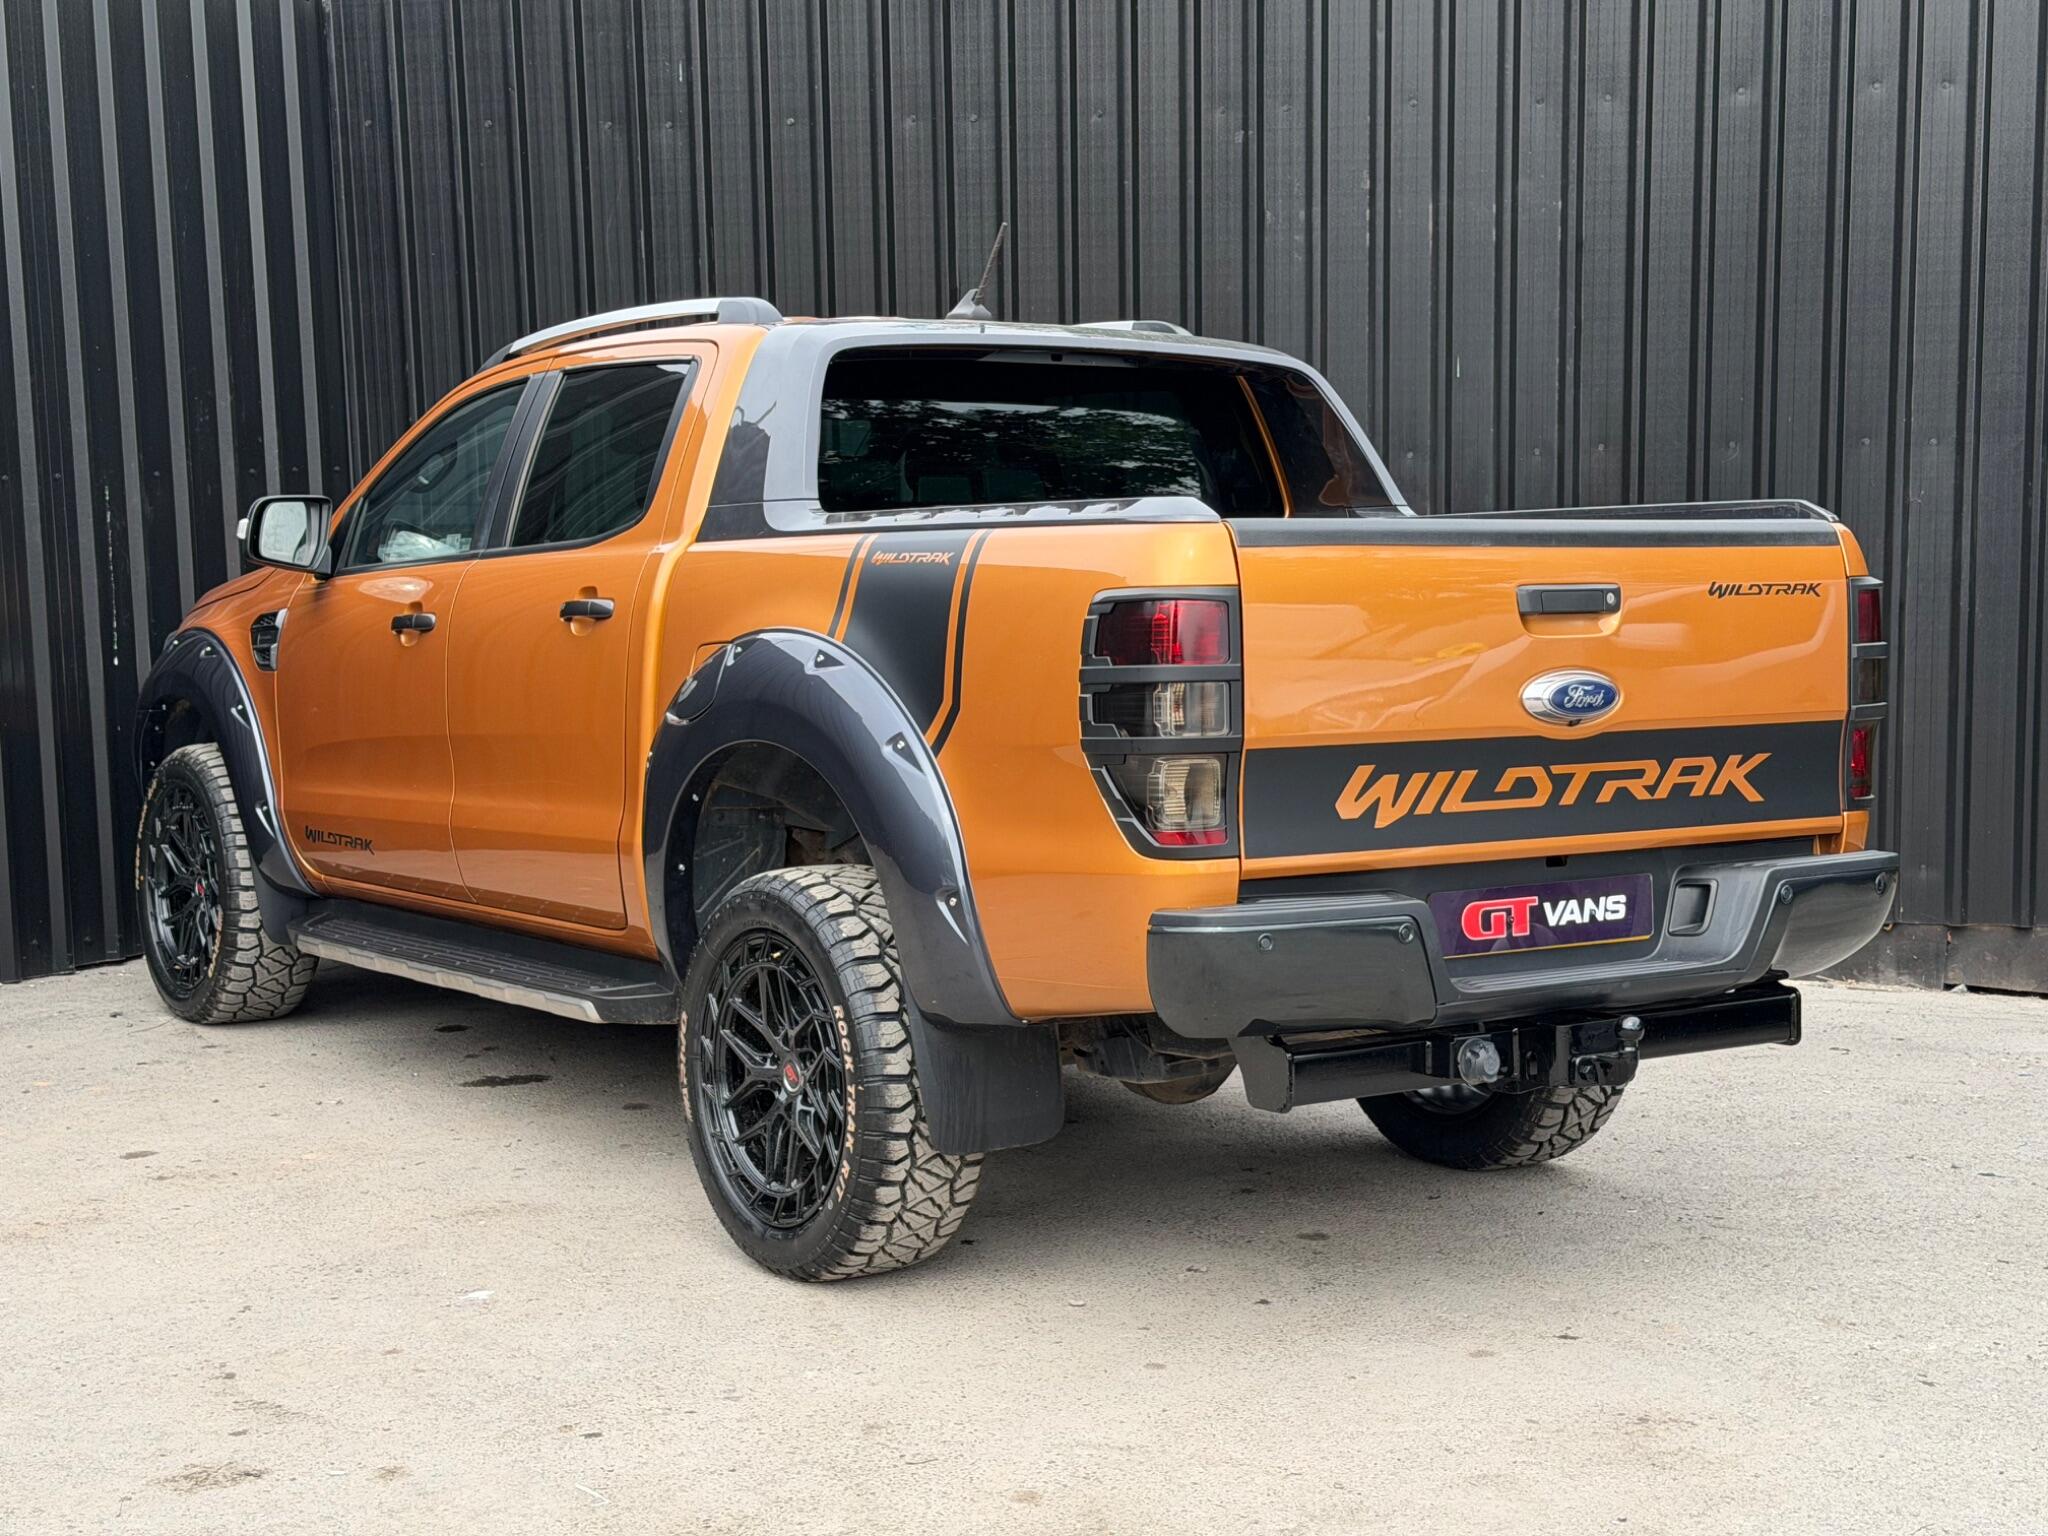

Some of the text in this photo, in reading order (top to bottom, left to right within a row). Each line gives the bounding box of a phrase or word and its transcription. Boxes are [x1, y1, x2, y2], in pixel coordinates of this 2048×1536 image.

[871, 550, 955, 566] WILDTRAK
[1707, 581, 1822, 599] WILDTRAK
[1563, 684, 1605, 709] Ford
[1335, 752, 1772, 829] WILDTRAK
[305, 825, 375, 855] WILDTRAK
[1461, 894, 1627, 941] GT VANS
[833, 1004, 855, 1073] ROCK
[846, 1083, 857, 1153] TRAK
